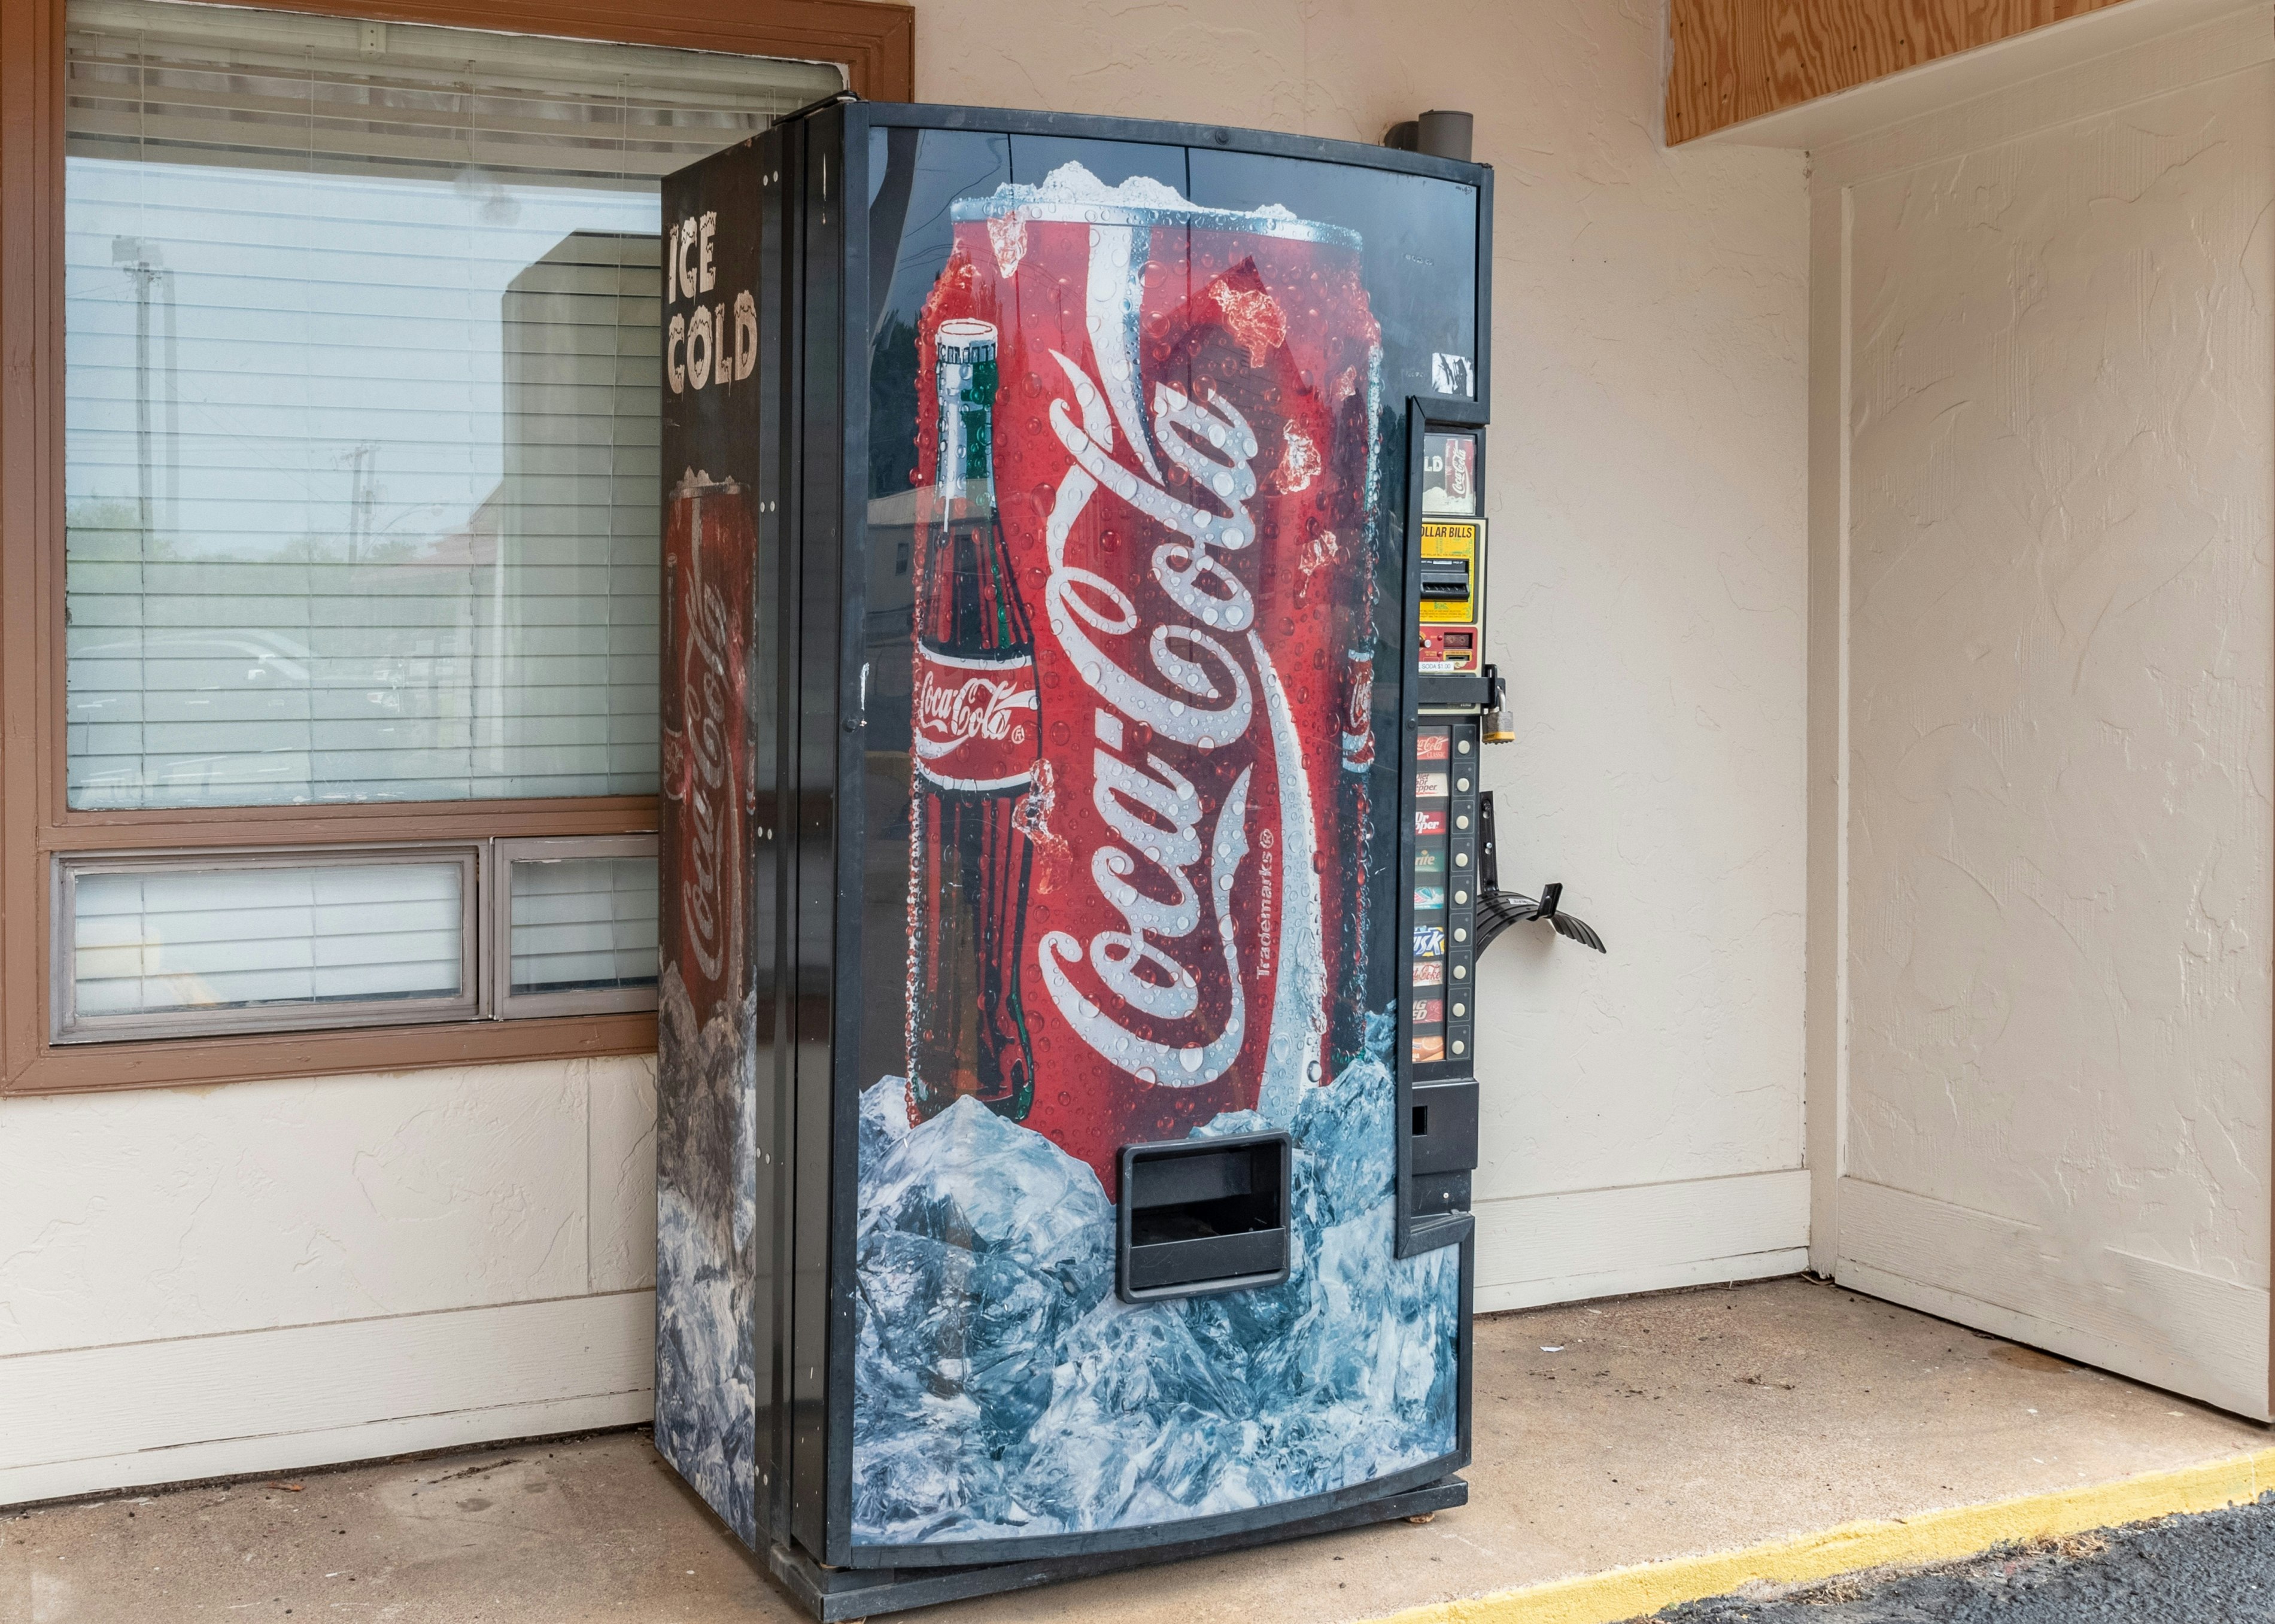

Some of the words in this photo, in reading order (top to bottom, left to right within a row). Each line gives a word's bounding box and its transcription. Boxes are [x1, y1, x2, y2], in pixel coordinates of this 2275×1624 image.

[669, 211, 717, 305] ICE
[667, 290, 757, 401] COLD
[1449, 527, 1472, 538] BILLS
[683, 566, 727, 981] Coca-Cola
[1038, 348, 1258, 1088] Coca-Cola
